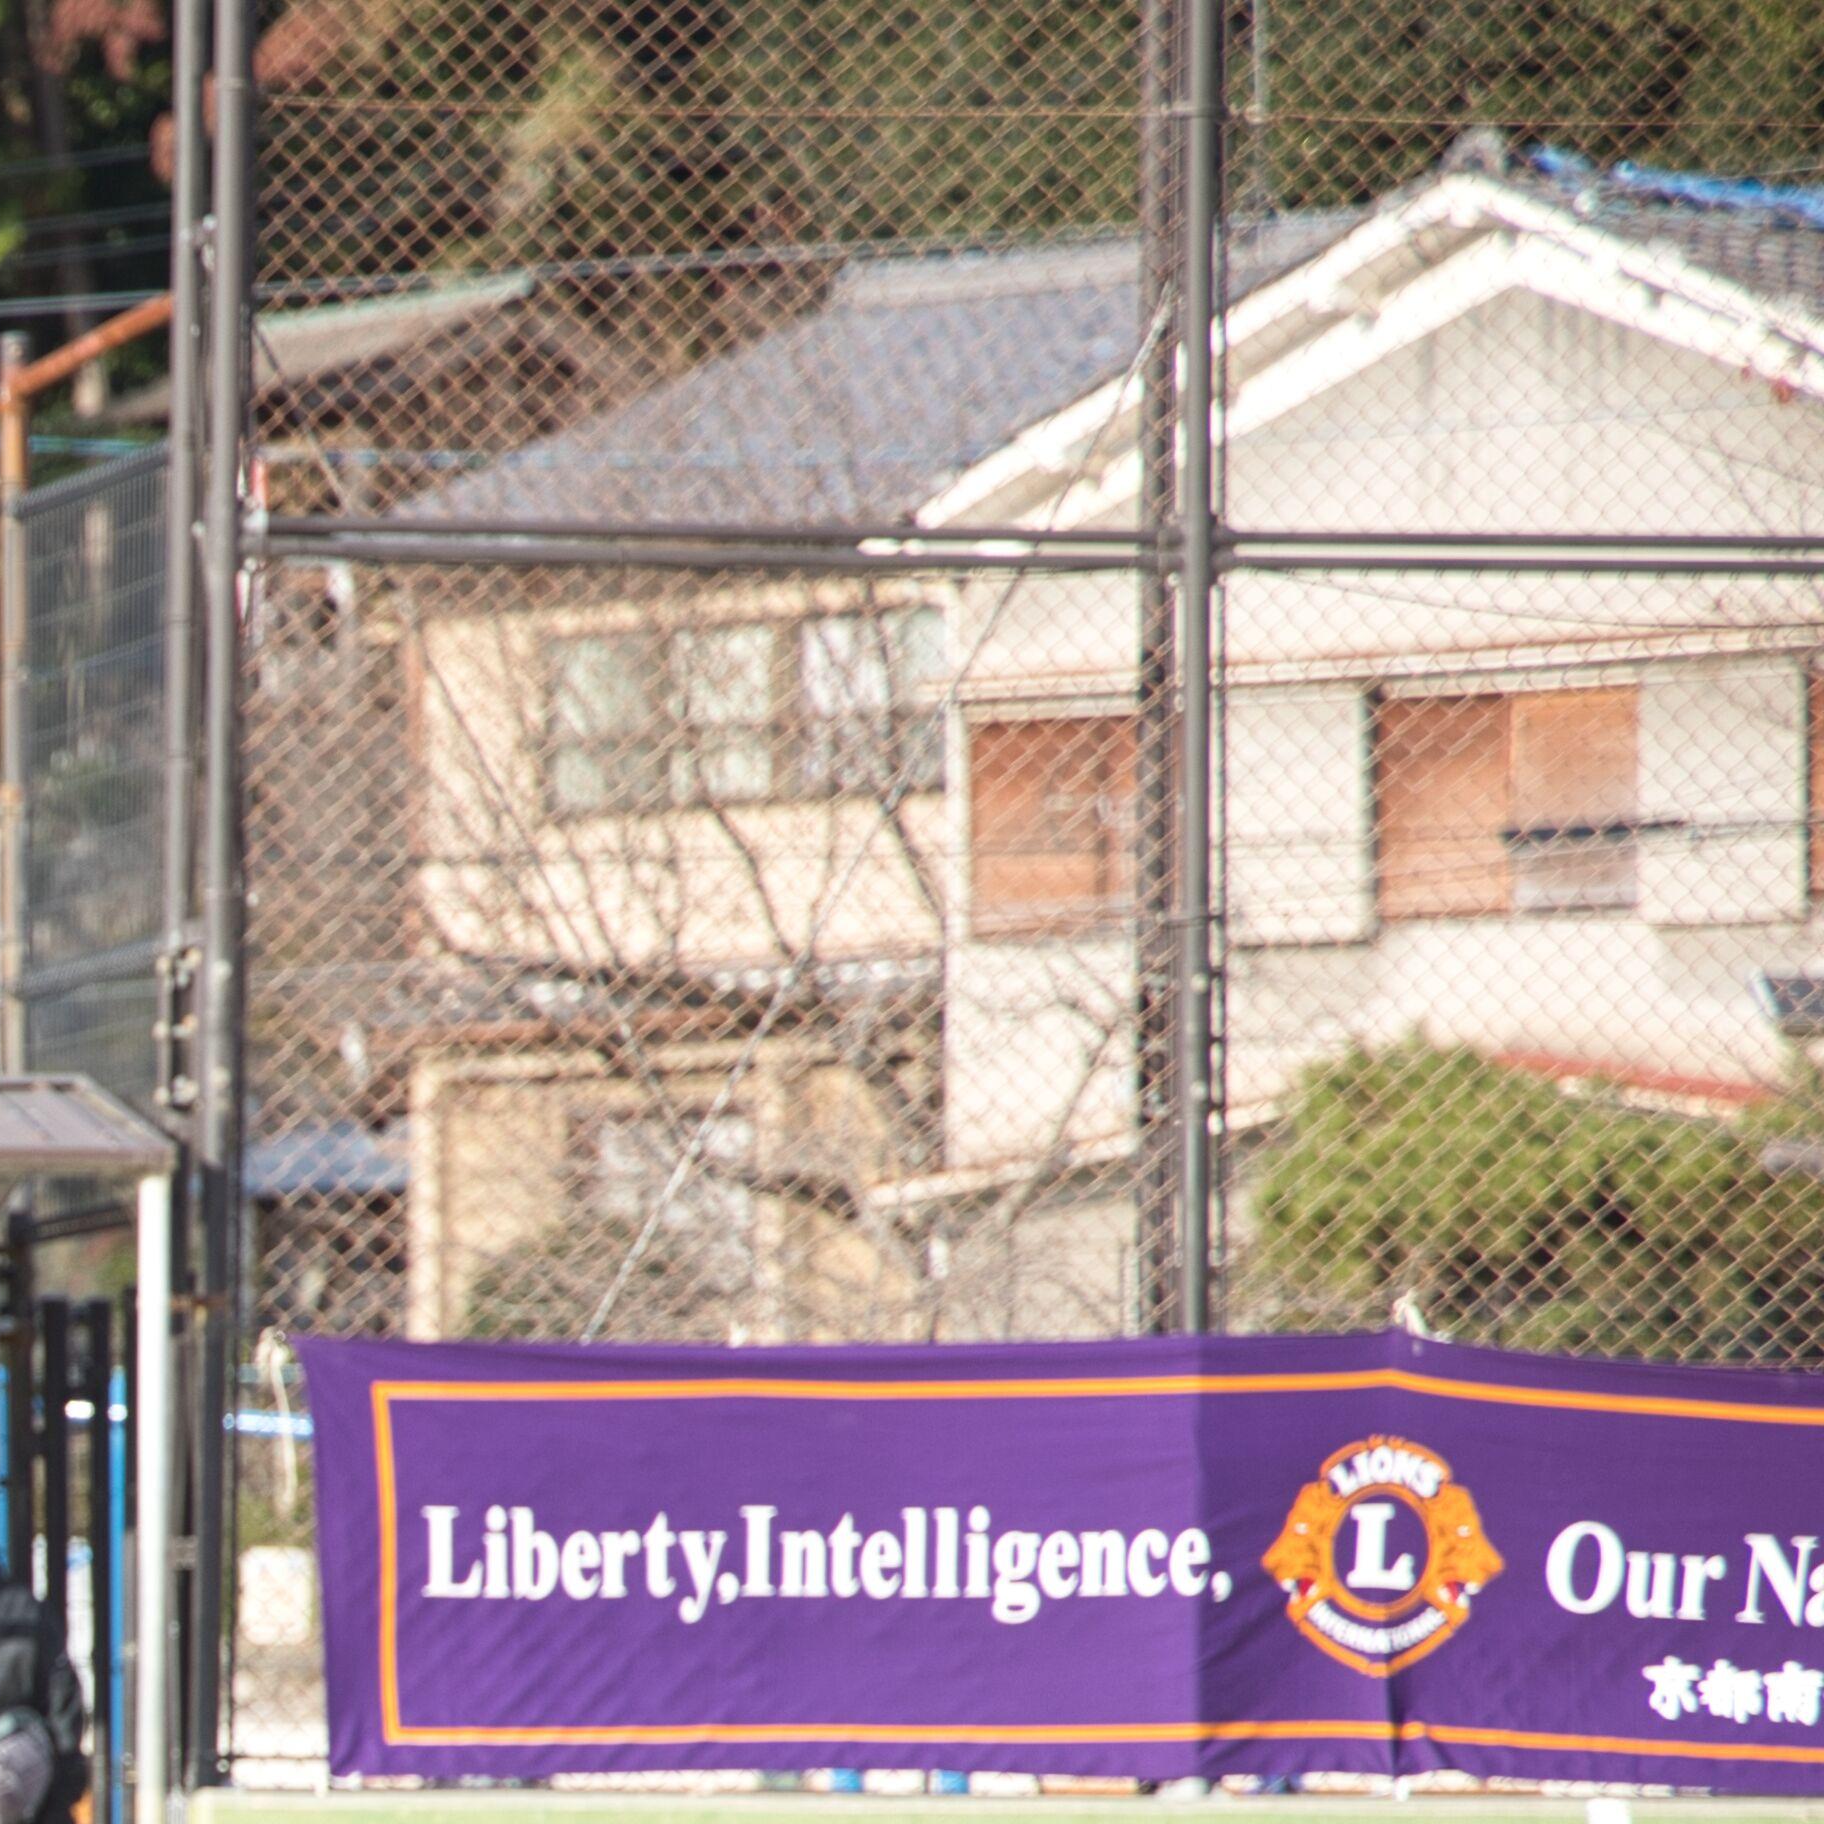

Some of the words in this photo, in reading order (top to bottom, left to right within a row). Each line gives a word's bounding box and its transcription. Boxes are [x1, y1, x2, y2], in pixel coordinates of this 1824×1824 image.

[1328, 1445, 1445, 1498] LIONS
[1346, 1503, 1416, 1591] L
[1545, 1520, 1727, 1621] Our
